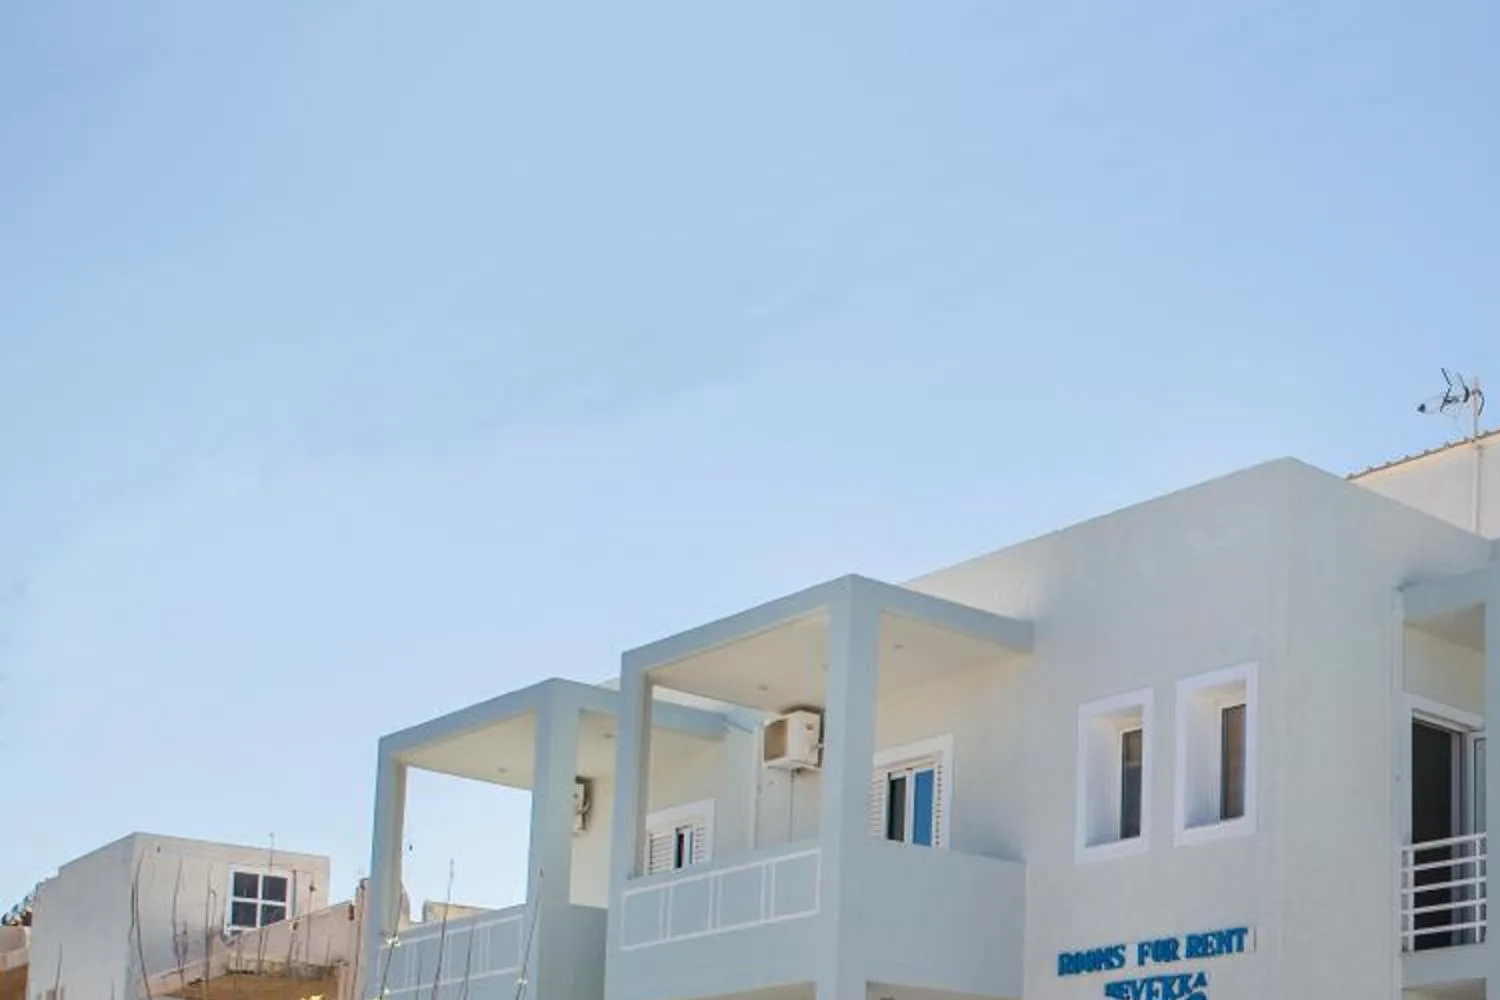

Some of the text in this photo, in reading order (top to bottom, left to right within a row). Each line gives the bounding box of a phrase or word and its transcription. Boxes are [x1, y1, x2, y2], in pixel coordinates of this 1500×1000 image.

[1058, 926, 1248, 976] ROOMS FOR RENT
